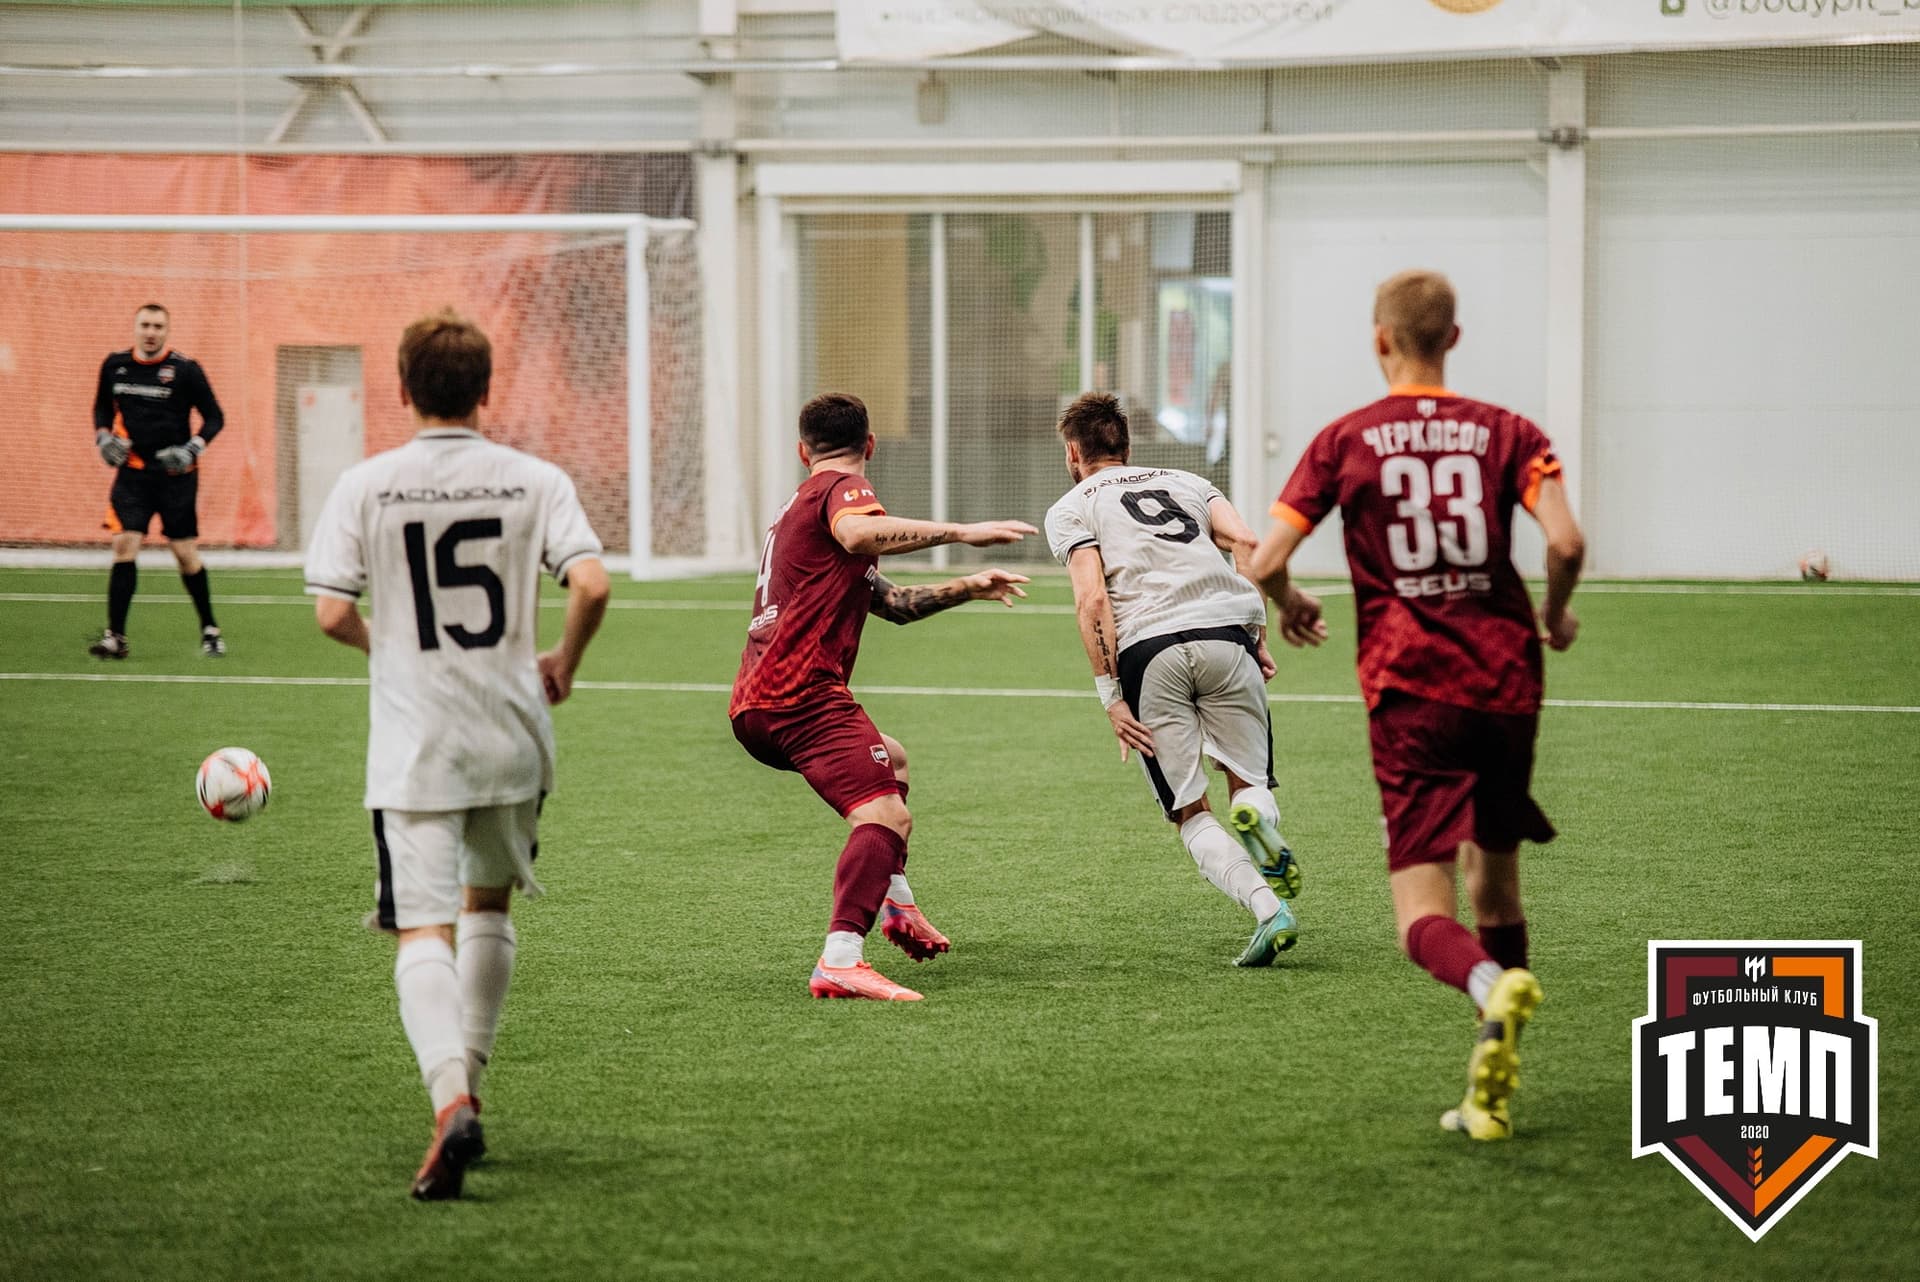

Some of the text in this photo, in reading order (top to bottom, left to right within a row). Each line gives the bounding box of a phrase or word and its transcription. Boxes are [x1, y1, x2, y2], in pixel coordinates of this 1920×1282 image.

[1362, 419, 1490, 457] ЧЕРКАСОВ
[1120, 489, 1200, 544] 9
[1381, 454, 1489, 571] 33
[403, 517, 506, 651] 15
[1393, 572, 1492, 598] SEUS
[748, 604, 779, 632] EUS
